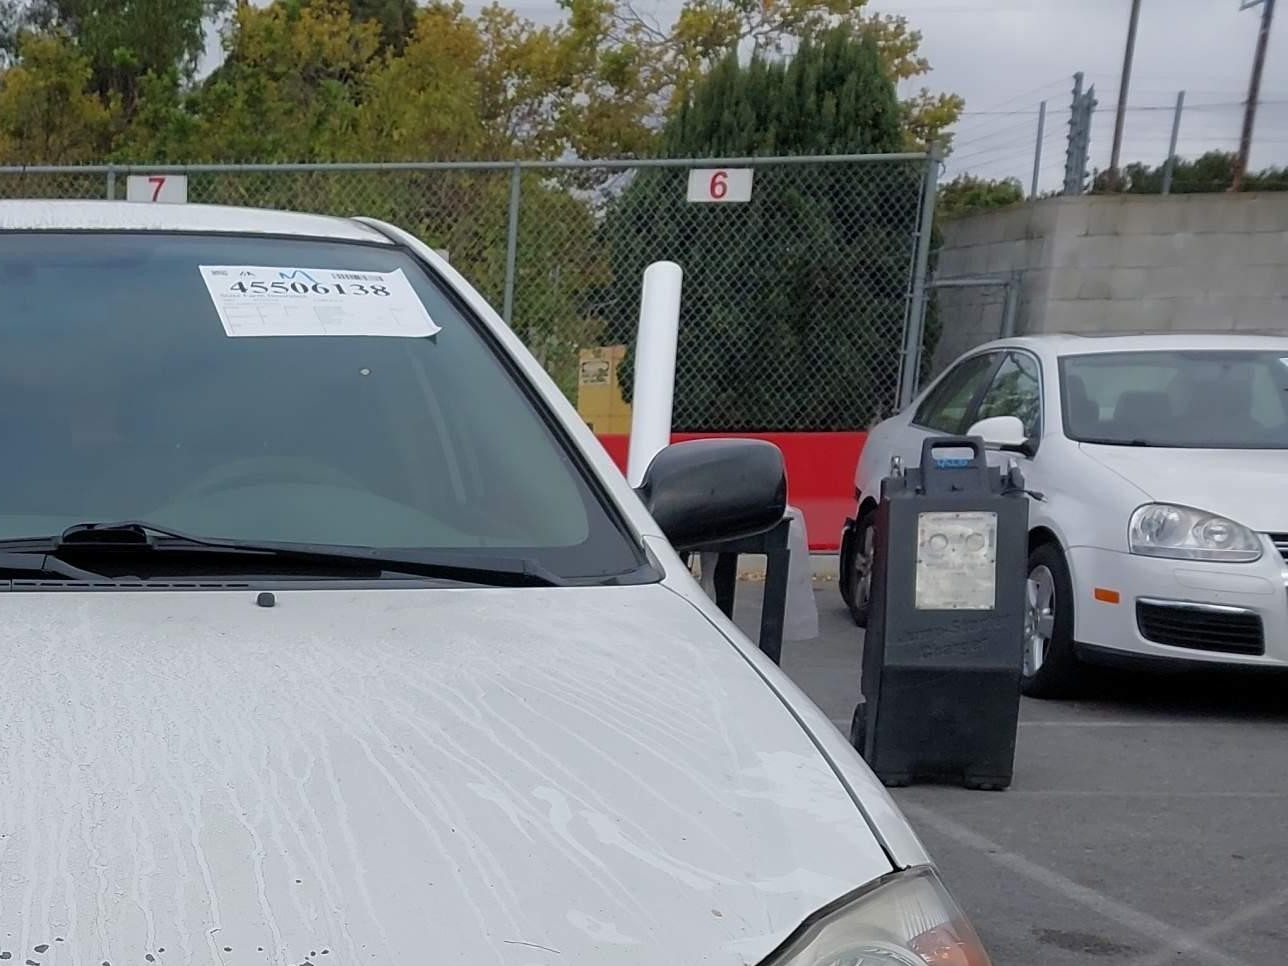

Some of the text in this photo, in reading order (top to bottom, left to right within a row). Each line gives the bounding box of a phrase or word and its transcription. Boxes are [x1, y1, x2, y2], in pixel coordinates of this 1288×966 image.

[148, 178, 166, 202] 7
[710, 171, 727, 199] 6
[230, 281, 391, 297] 45506138
